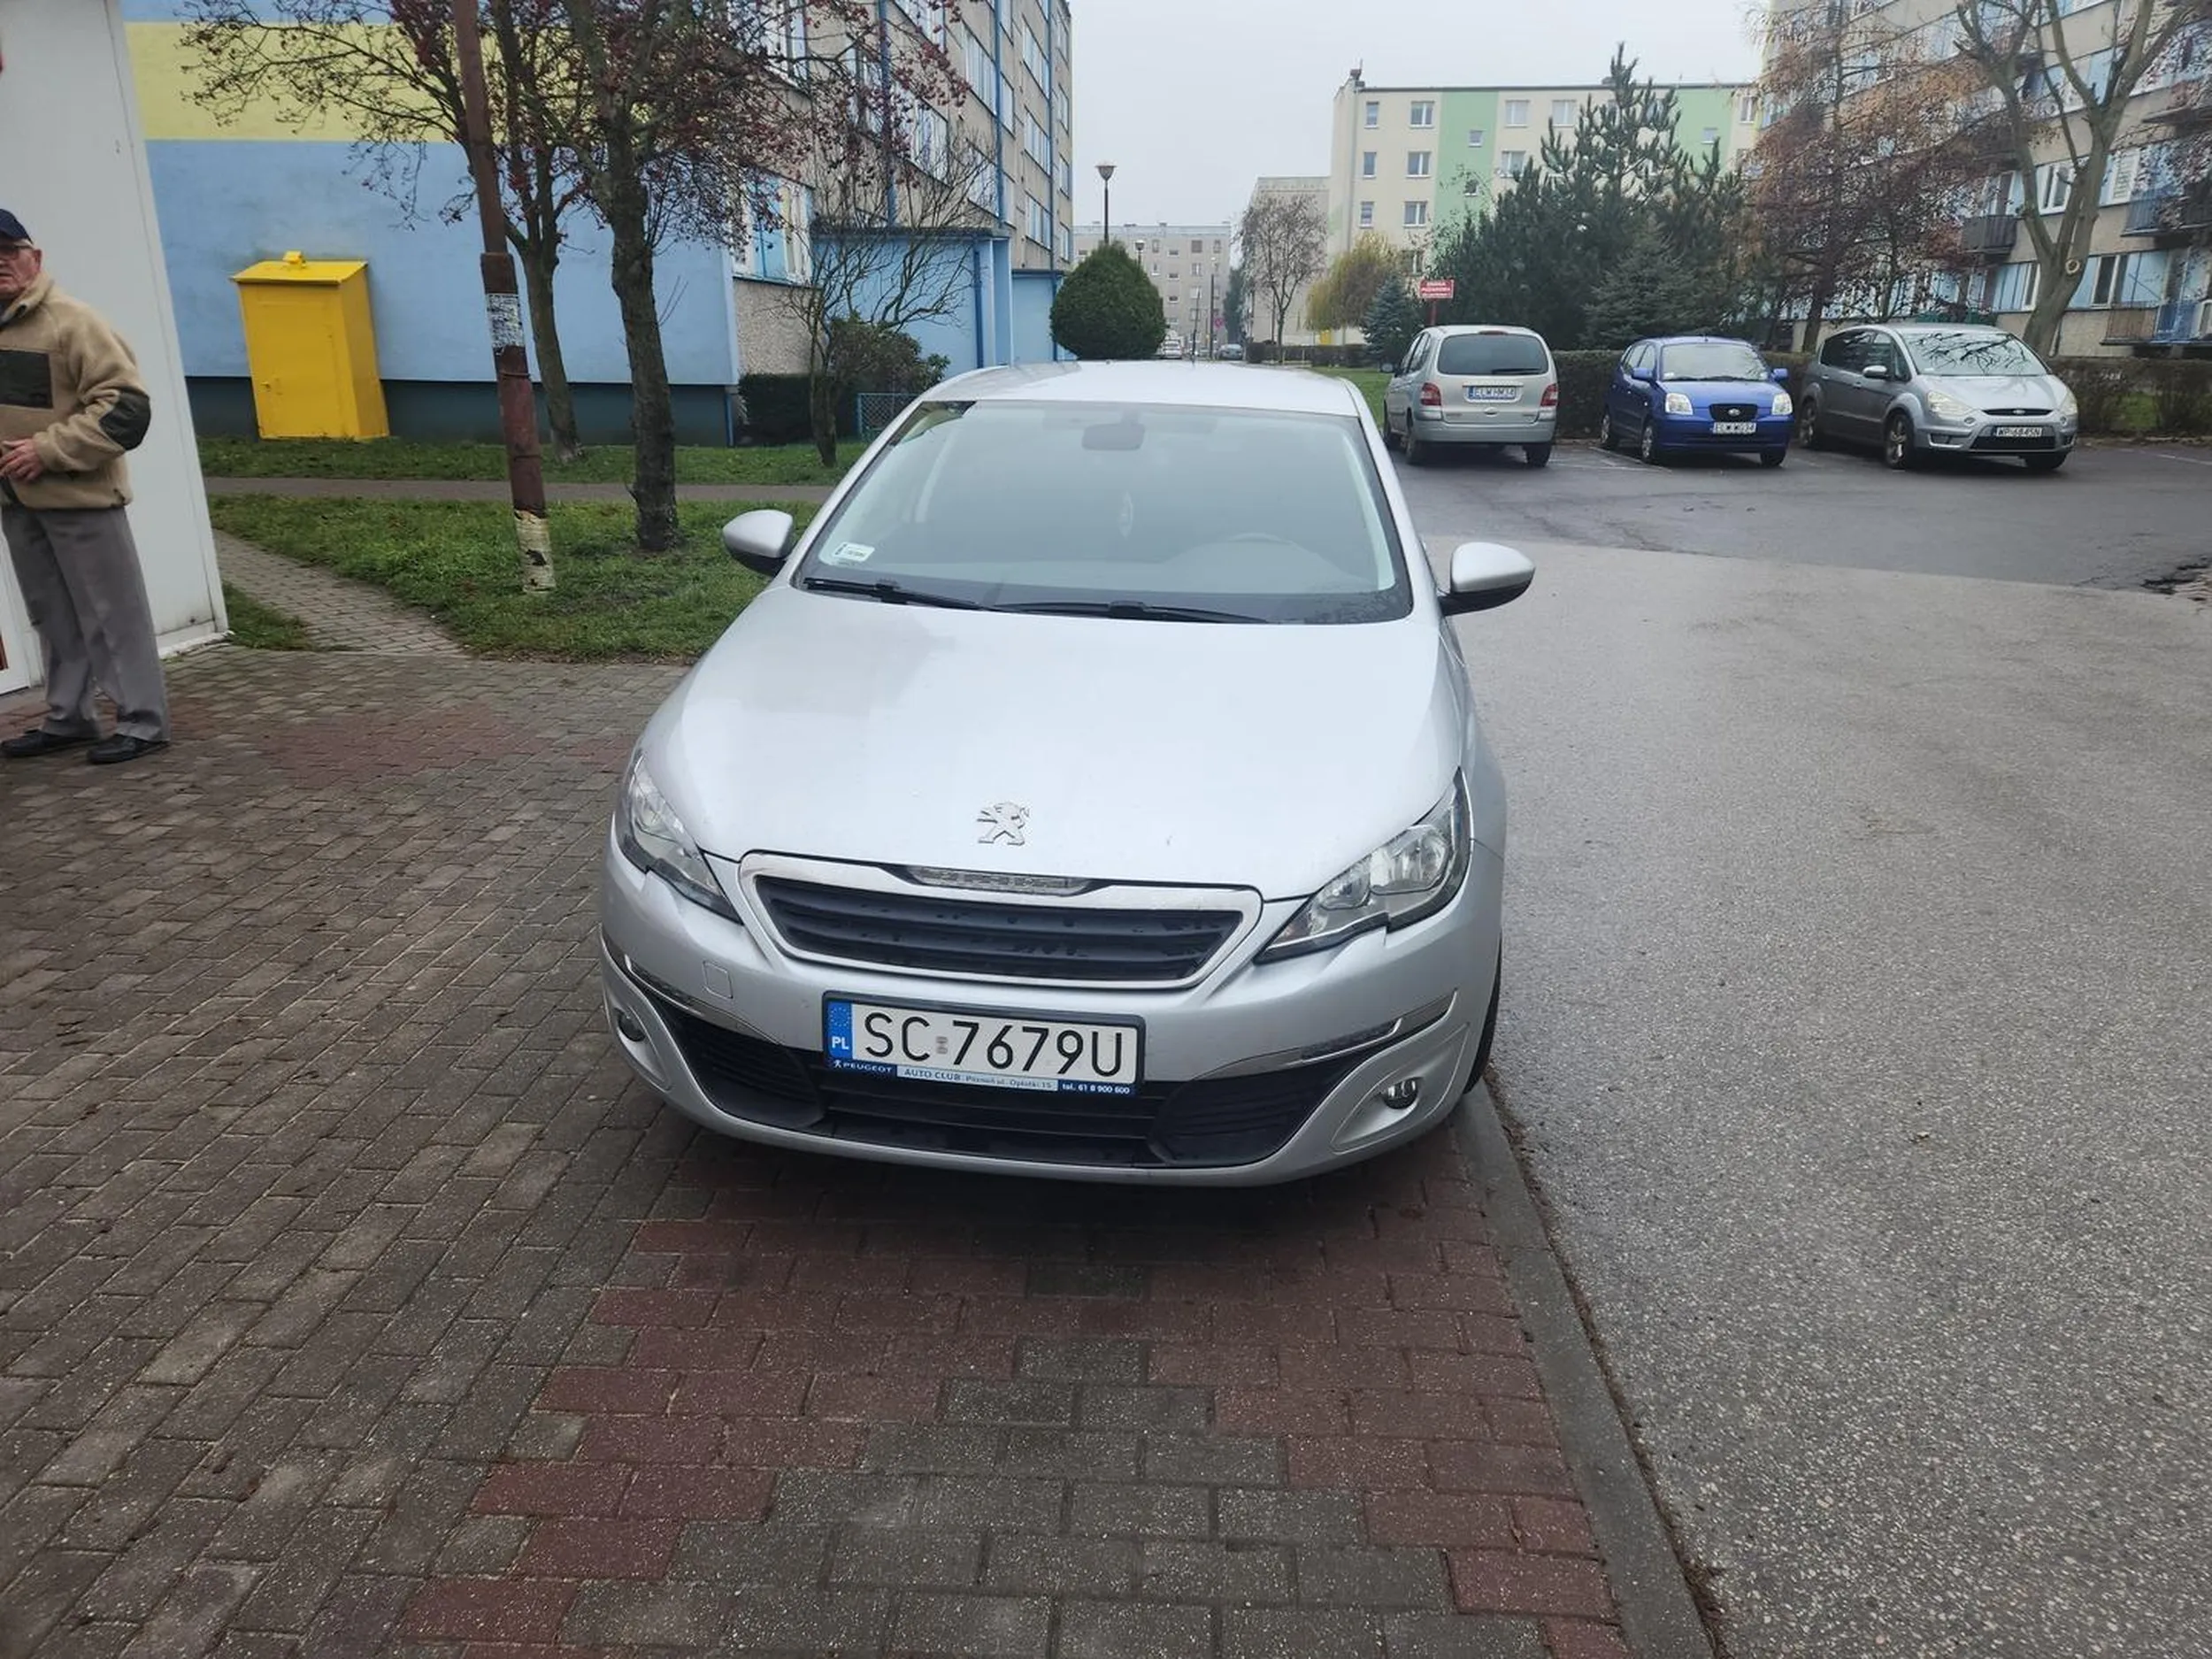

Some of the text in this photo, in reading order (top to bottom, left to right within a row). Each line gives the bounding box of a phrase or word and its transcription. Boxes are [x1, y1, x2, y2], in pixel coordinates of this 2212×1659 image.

[831, 1036, 849, 1051] PL
[864, 1012, 1122, 1078] SC 7679U
[843, 1062, 892, 1073] PEUGEOT
[904, 1068, 932, 1079] AUTO
[934, 1071, 962, 1081] CLUB
